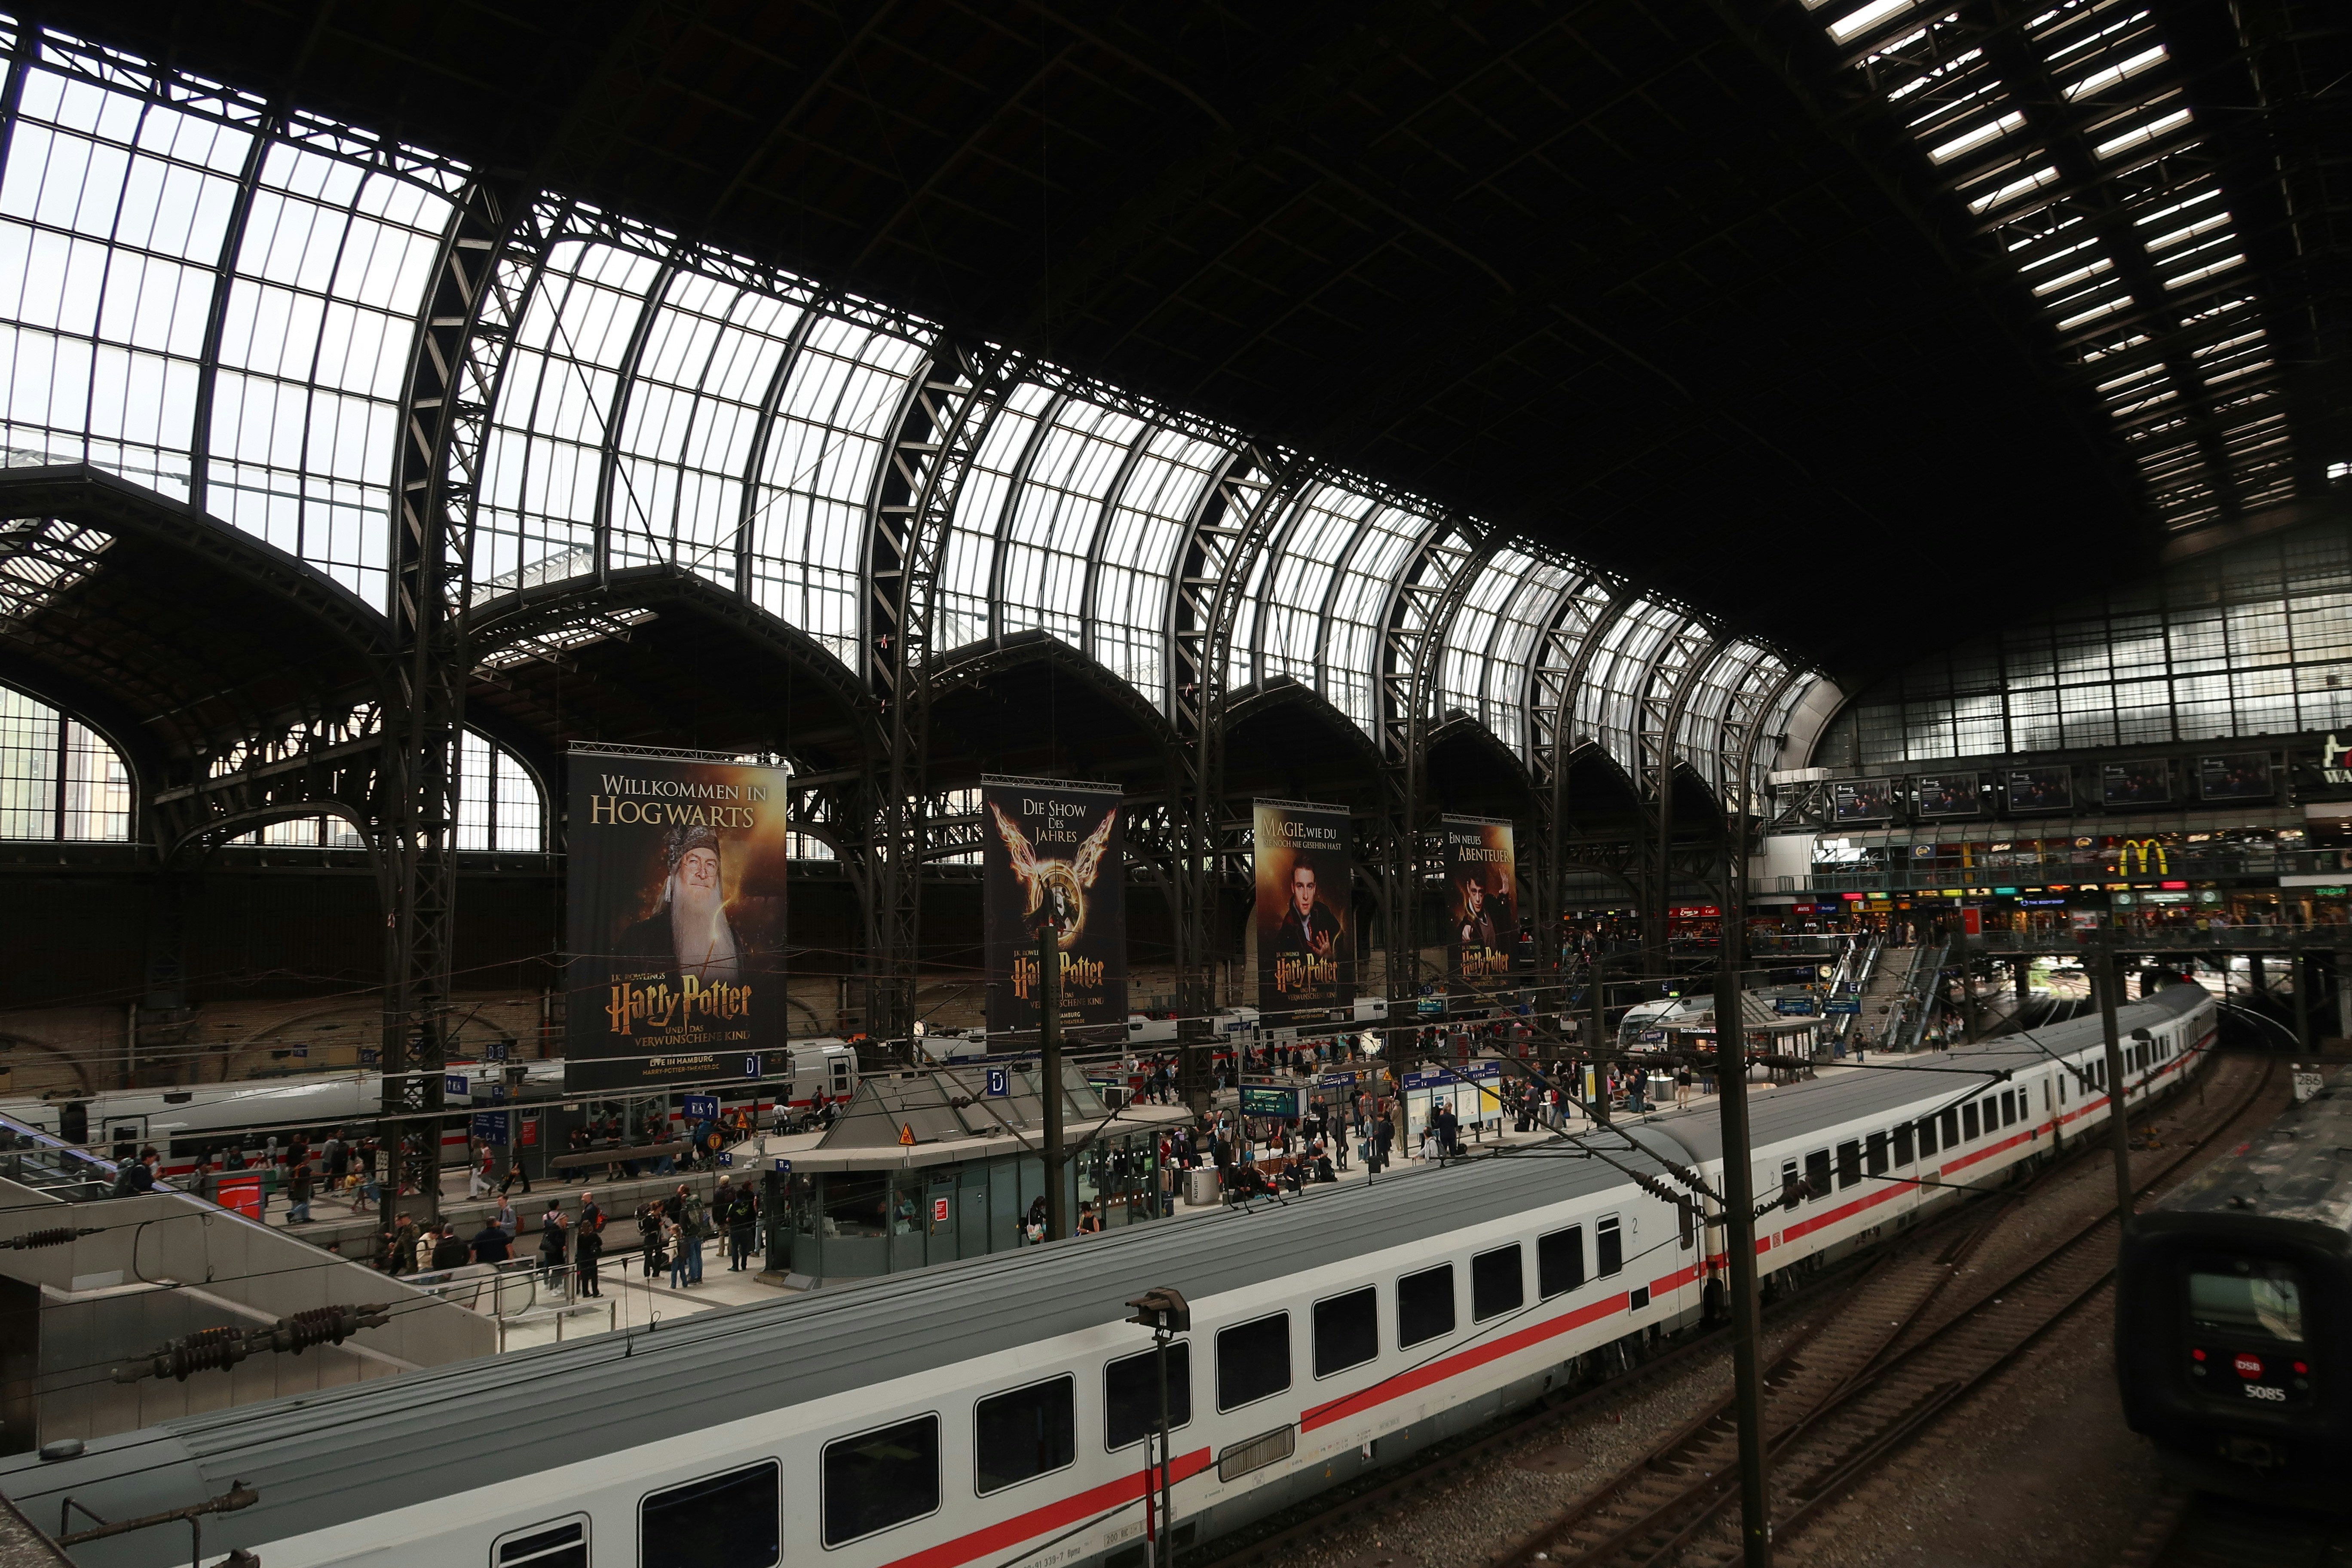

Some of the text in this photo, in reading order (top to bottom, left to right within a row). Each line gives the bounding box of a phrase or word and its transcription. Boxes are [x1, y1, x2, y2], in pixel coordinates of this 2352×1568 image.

[601, 774, 766, 801] WILLKOMMEN IN
[591, 795, 754, 828] HOGWARTS
[1023, 798, 1086, 817] DIE SHOW
[1048, 817, 1064, 829] DES
[1262, 817, 1336, 839] MAGIE, WIE DU
[1035, 827, 1077, 845] JAHRES
[1449, 832, 1481, 845] EIN NEUES
[1303, 841, 1326, 849] GESEHEN
[1458, 845, 1510, 863] ABENTEUER
[1058, 951, 1104, 1000] Potter
[1274, 953, 1338, 993] Harry Potter
[605, 975, 752, 1035] Harry Potter
[1087, 997, 1104, 1005] KIND
[634, 1030, 750, 1047] VERWUNSCHENE KIND
[677, 1055, 713, 1065] HAMBURG
[746, 1057, 754, 1074] D
[992, 1072, 1003, 1092] D
[2298, 1075, 2321, 1085] 286
[1770, 1171, 1774, 1185] 2
[1632, 1218, 1638, 1234] 2
[2235, 1359, 2261, 1372] DSB
[2244, 1384, 2286, 1402] 5085
[1106, 1532, 1118, 1544] 200
